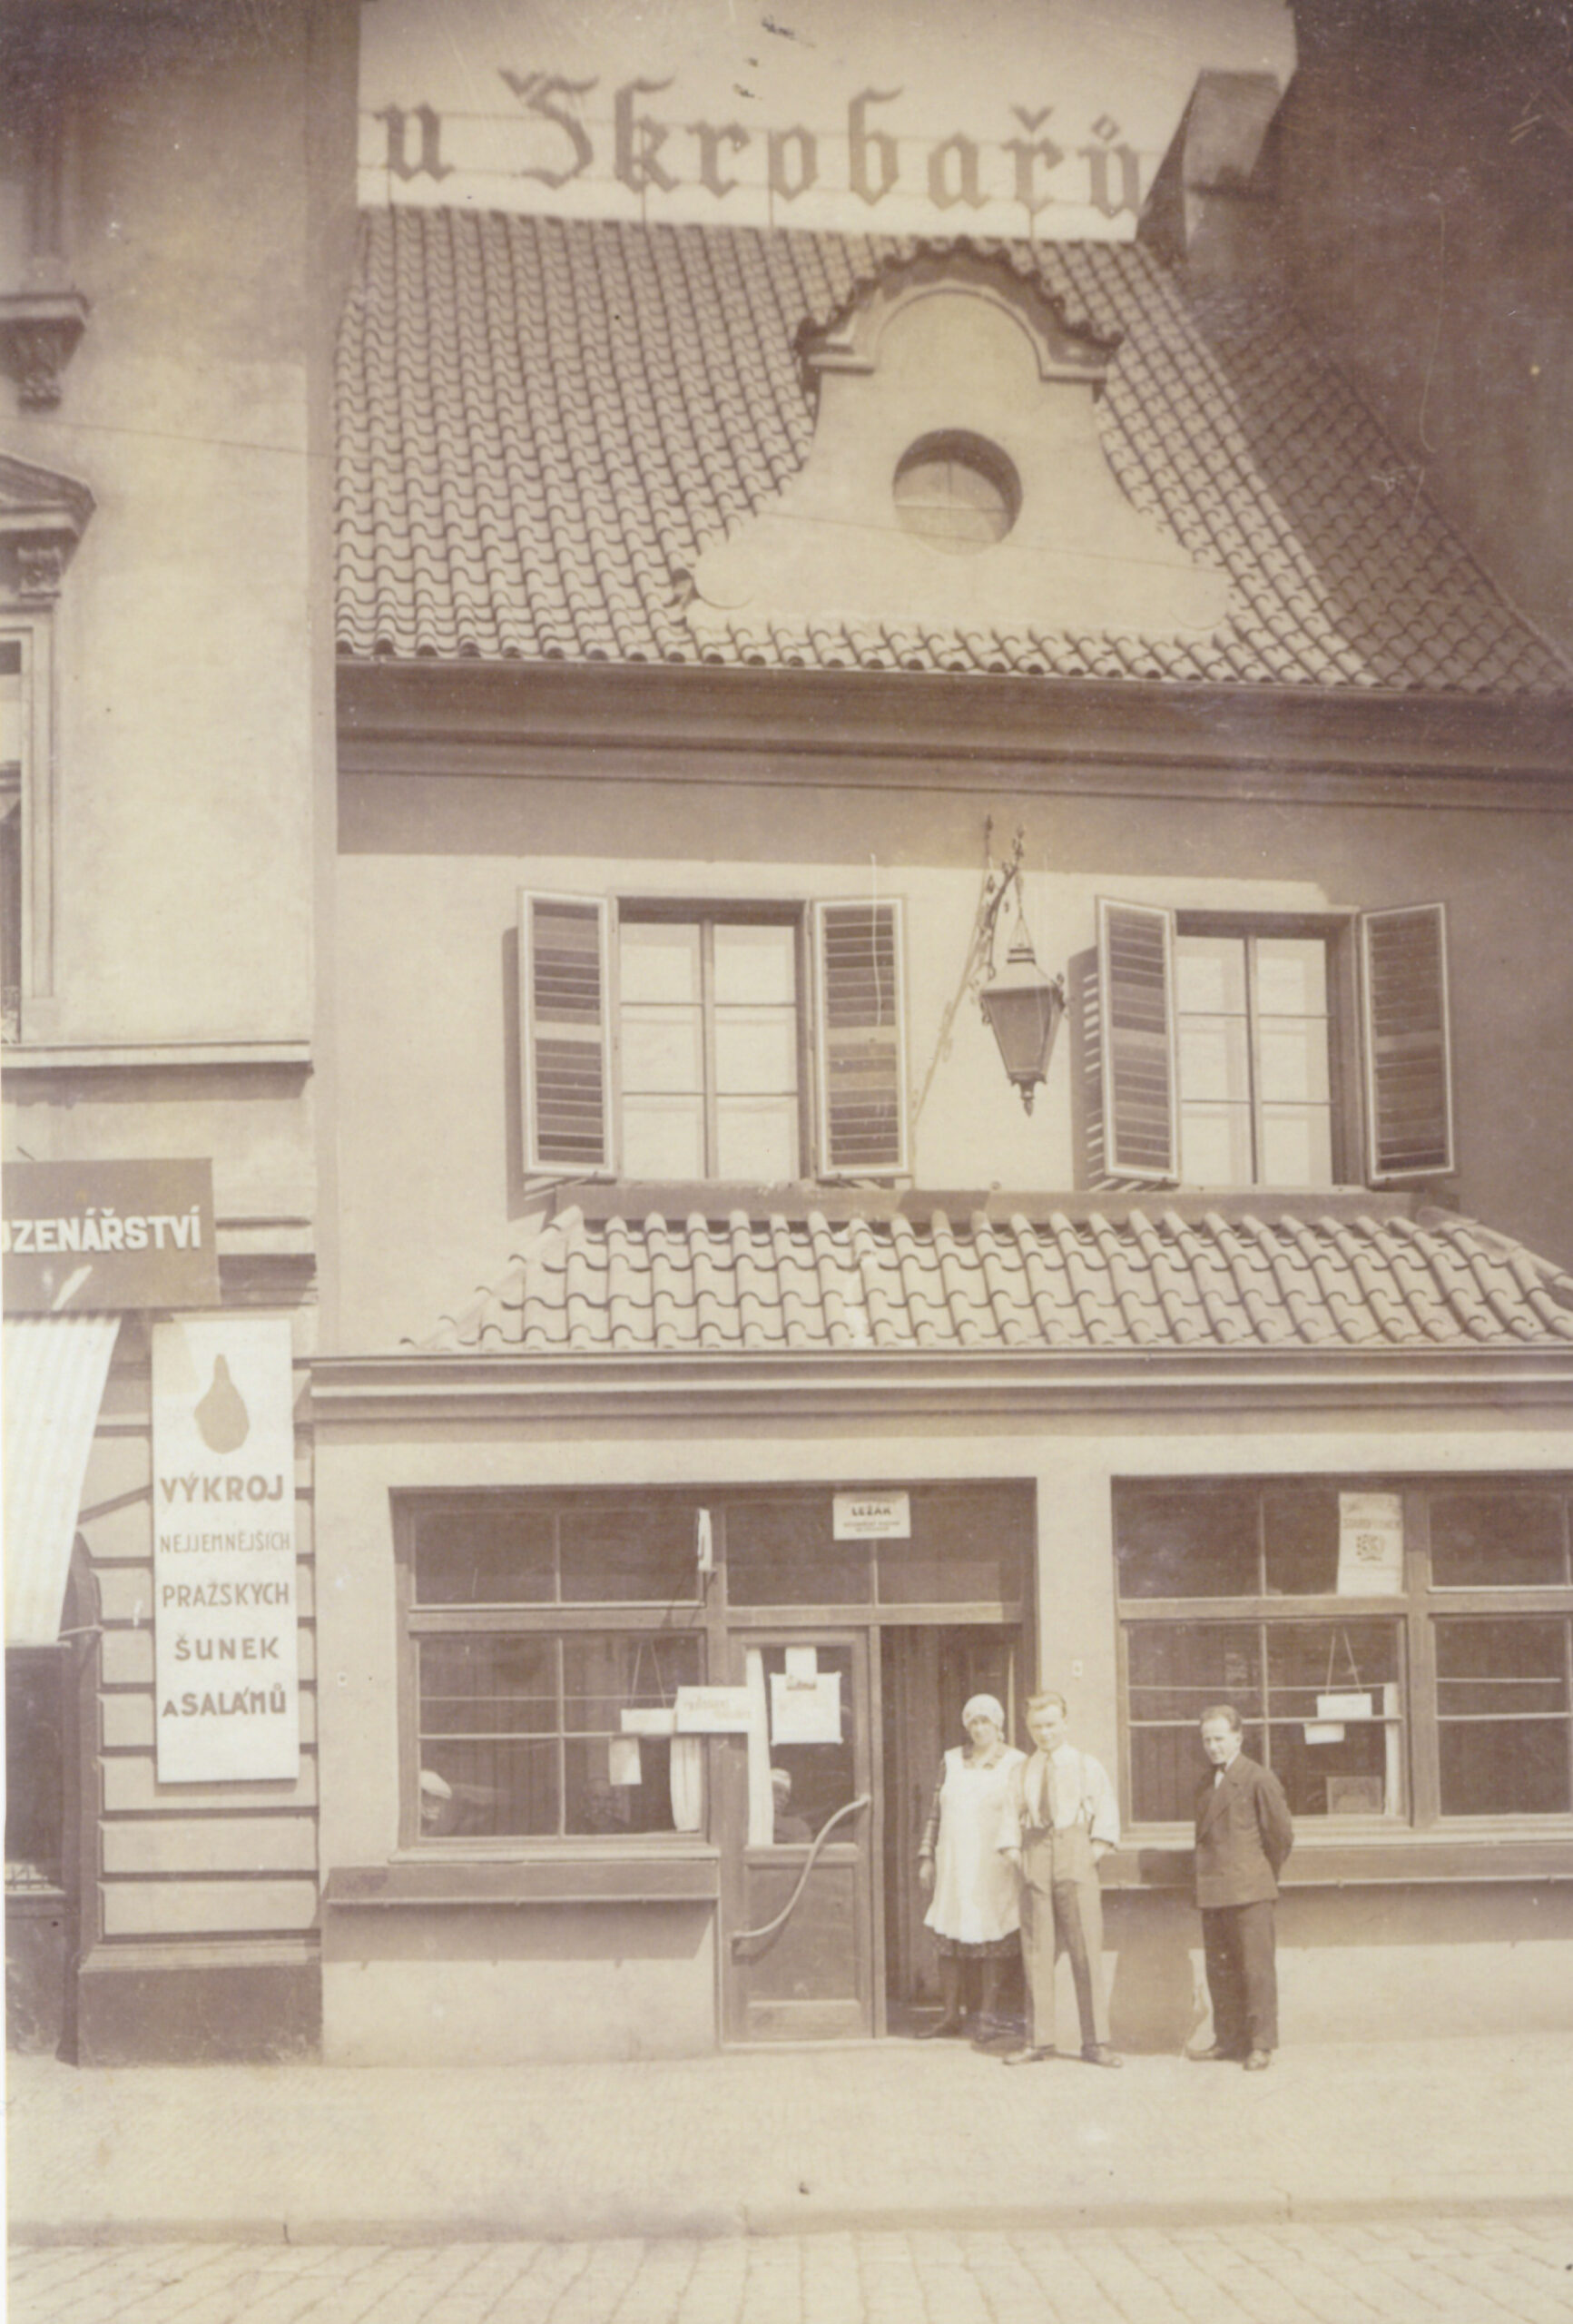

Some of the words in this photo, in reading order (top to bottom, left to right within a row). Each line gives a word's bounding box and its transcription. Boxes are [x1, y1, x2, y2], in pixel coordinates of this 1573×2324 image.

[160, 1472, 284, 1503] VÝKROJ
[174, 1634, 280, 1661] ŠUNEK
[181, 1683, 287, 1717] SALÁMŮ
